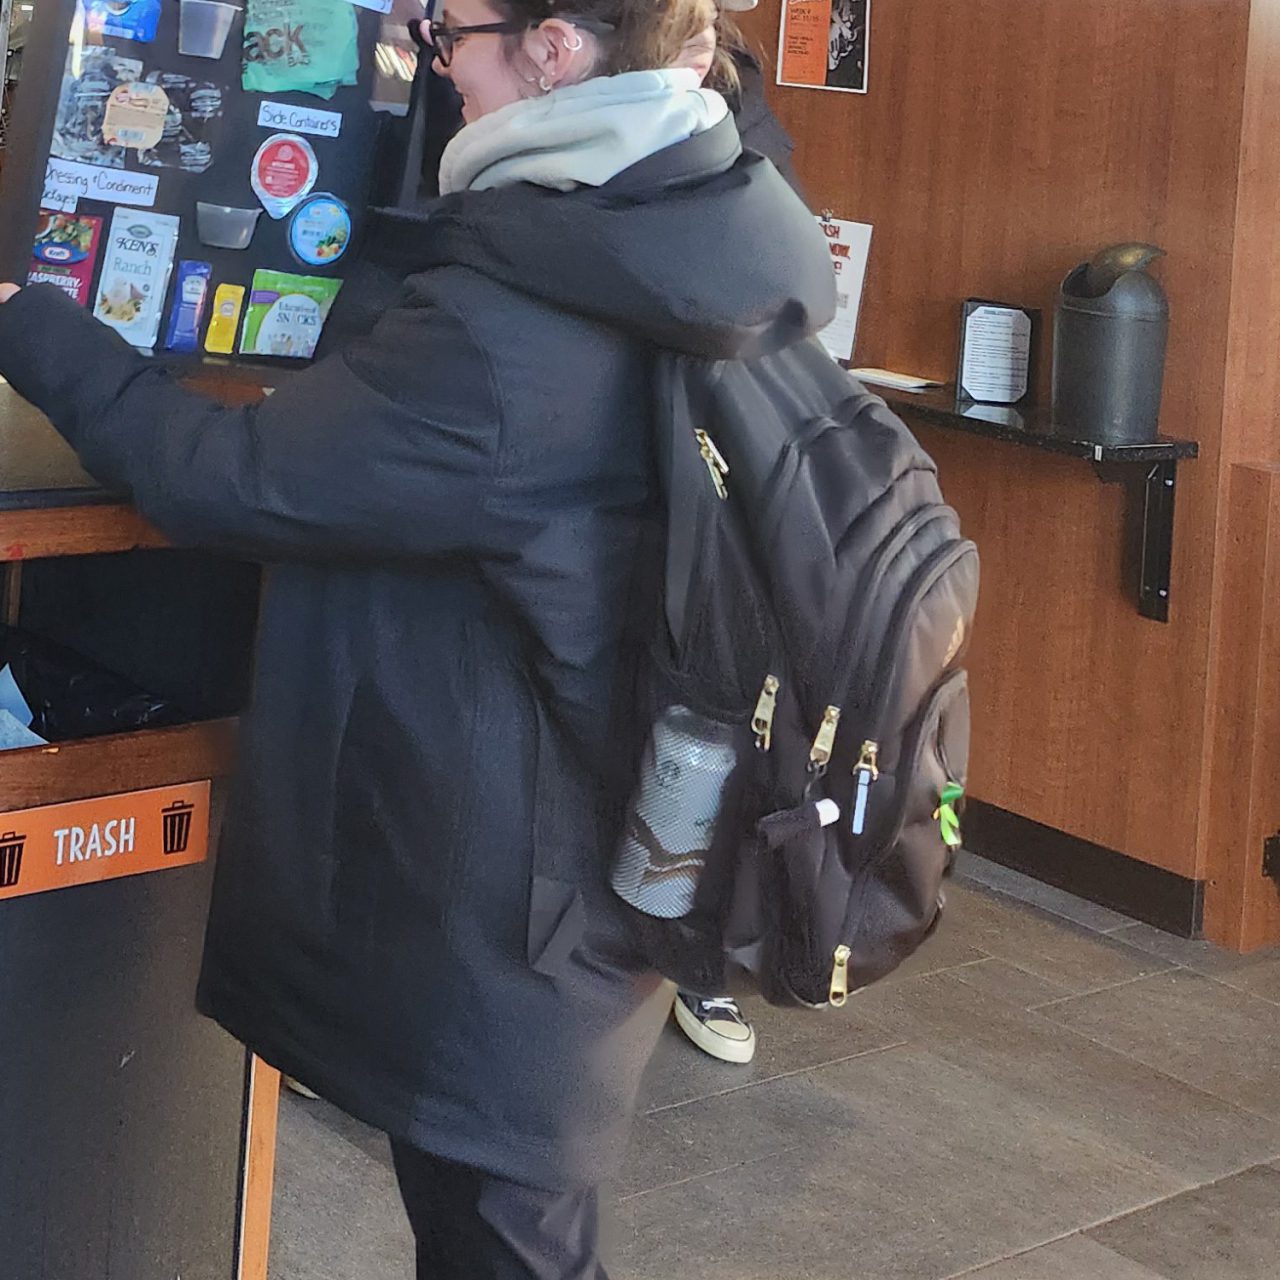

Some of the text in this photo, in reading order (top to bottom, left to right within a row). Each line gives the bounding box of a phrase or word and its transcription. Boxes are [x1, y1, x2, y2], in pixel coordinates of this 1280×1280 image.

[242, 19, 308, 62] ack
[116, 236, 160, 257] KEN'S
[113, 257, 152, 276] Ranch
[276, 311, 317, 326] SNCKS
[54, 817, 137, 866] TRASH
